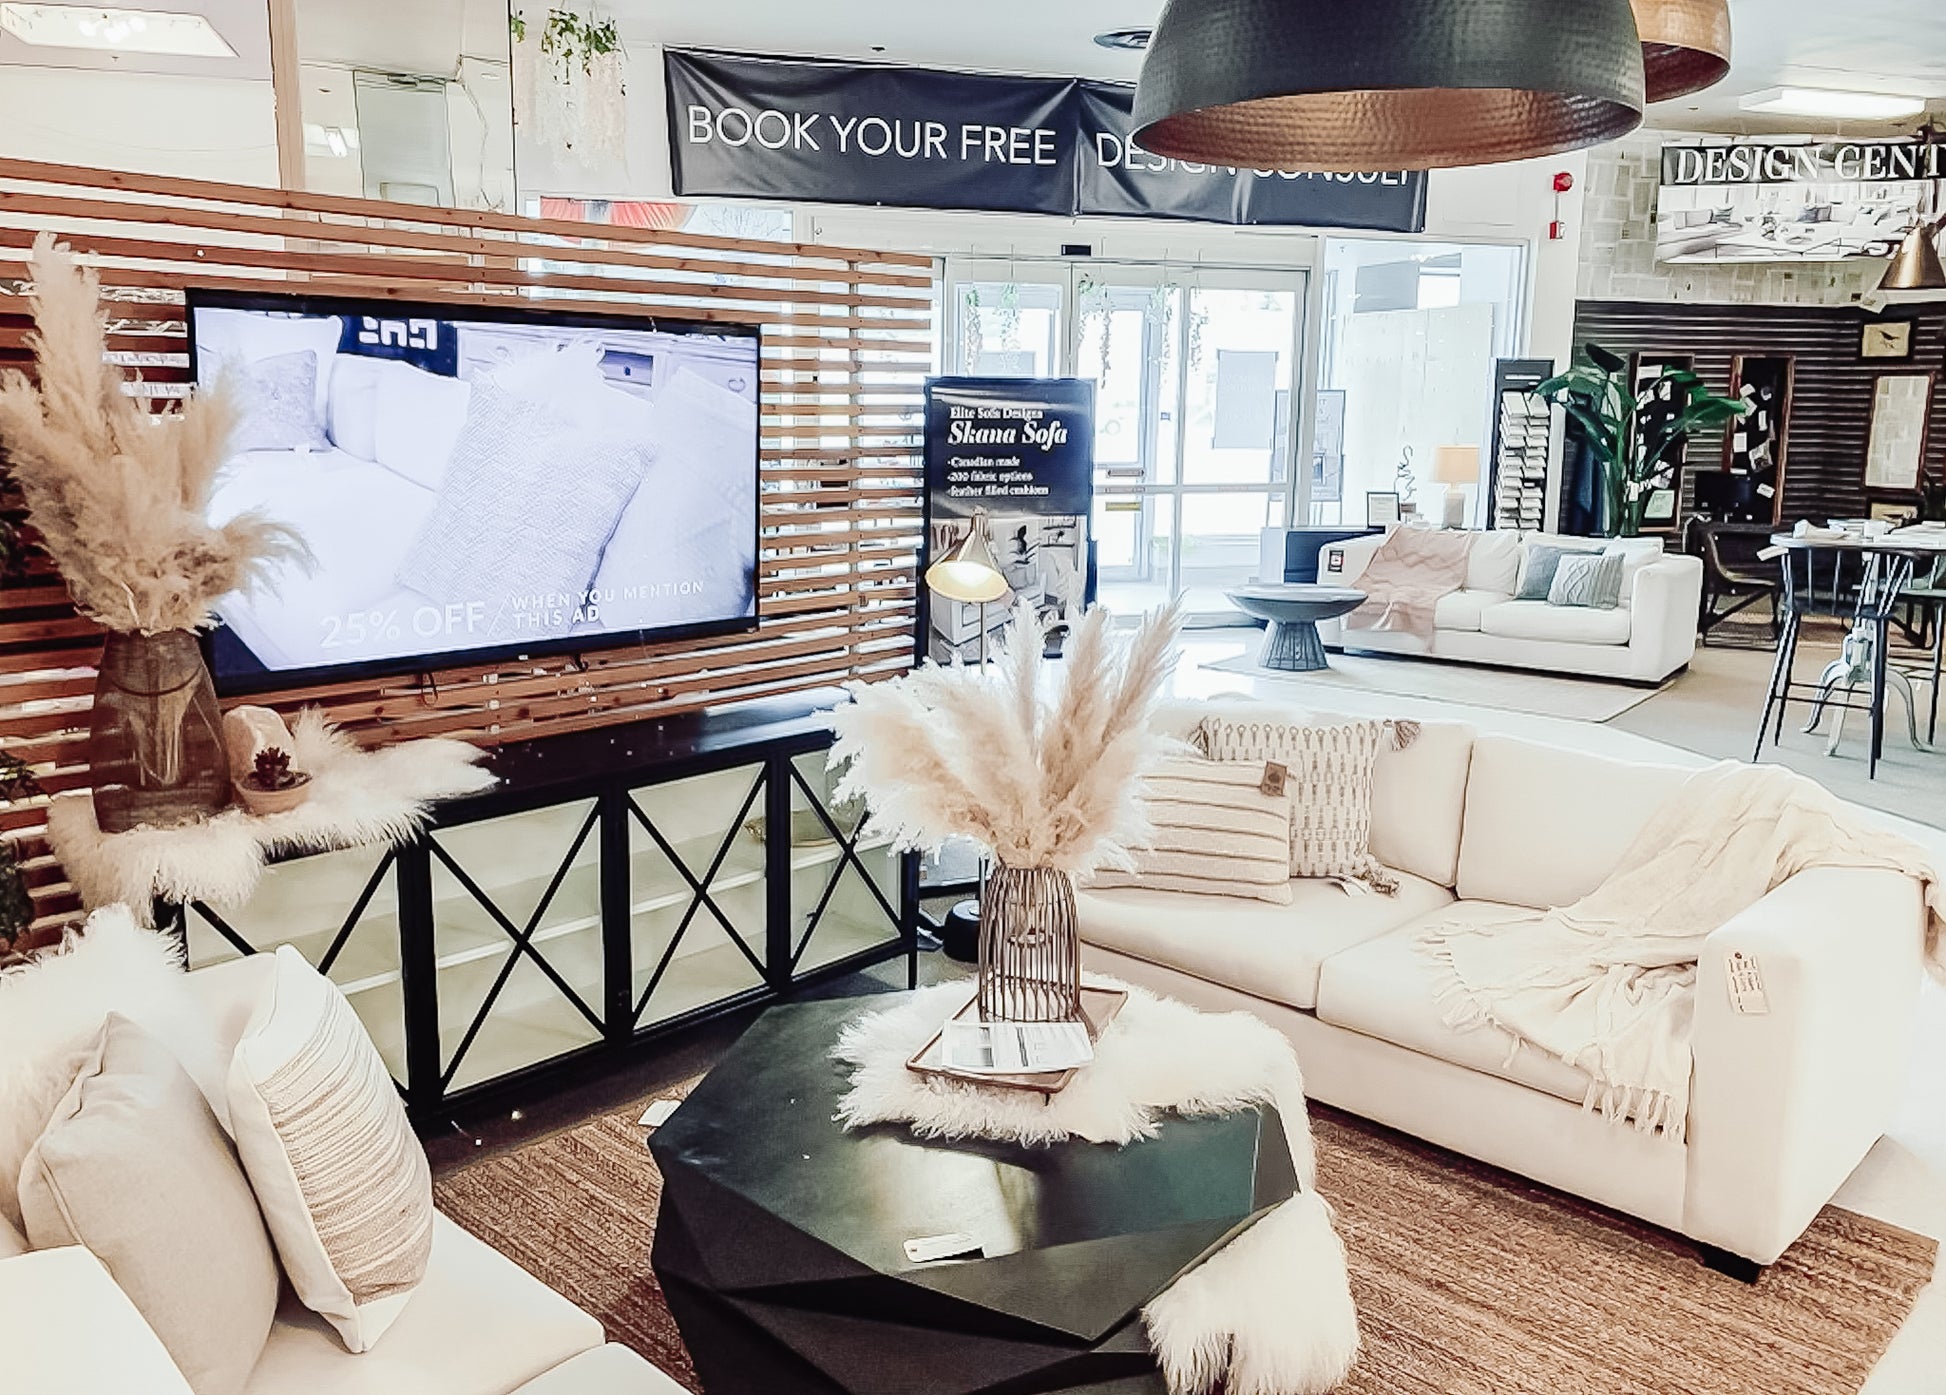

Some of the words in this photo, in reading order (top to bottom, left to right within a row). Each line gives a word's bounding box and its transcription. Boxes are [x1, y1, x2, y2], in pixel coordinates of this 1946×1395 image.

[687, 104, 820, 151] BOOK
[829, 114, 947, 159] YOUR
[960, 124, 1056, 165] FREE
[1674, 145, 1819, 184] DESIGN
[950, 405, 975, 419] Elite
[1003, 407, 1044, 422] Designs
[948, 420, 1017, 445] Skana
[1021, 420, 1068, 451] Sofa
[511, 592, 571, 610] WHEN
[577, 587, 615, 606] YOU
[623, 580, 704, 600] MENTION
[320, 608, 401, 648] 25%
[412, 600, 485, 638] OFF
[513, 609, 563, 629] THIS
[572, 604, 601, 624] AD
